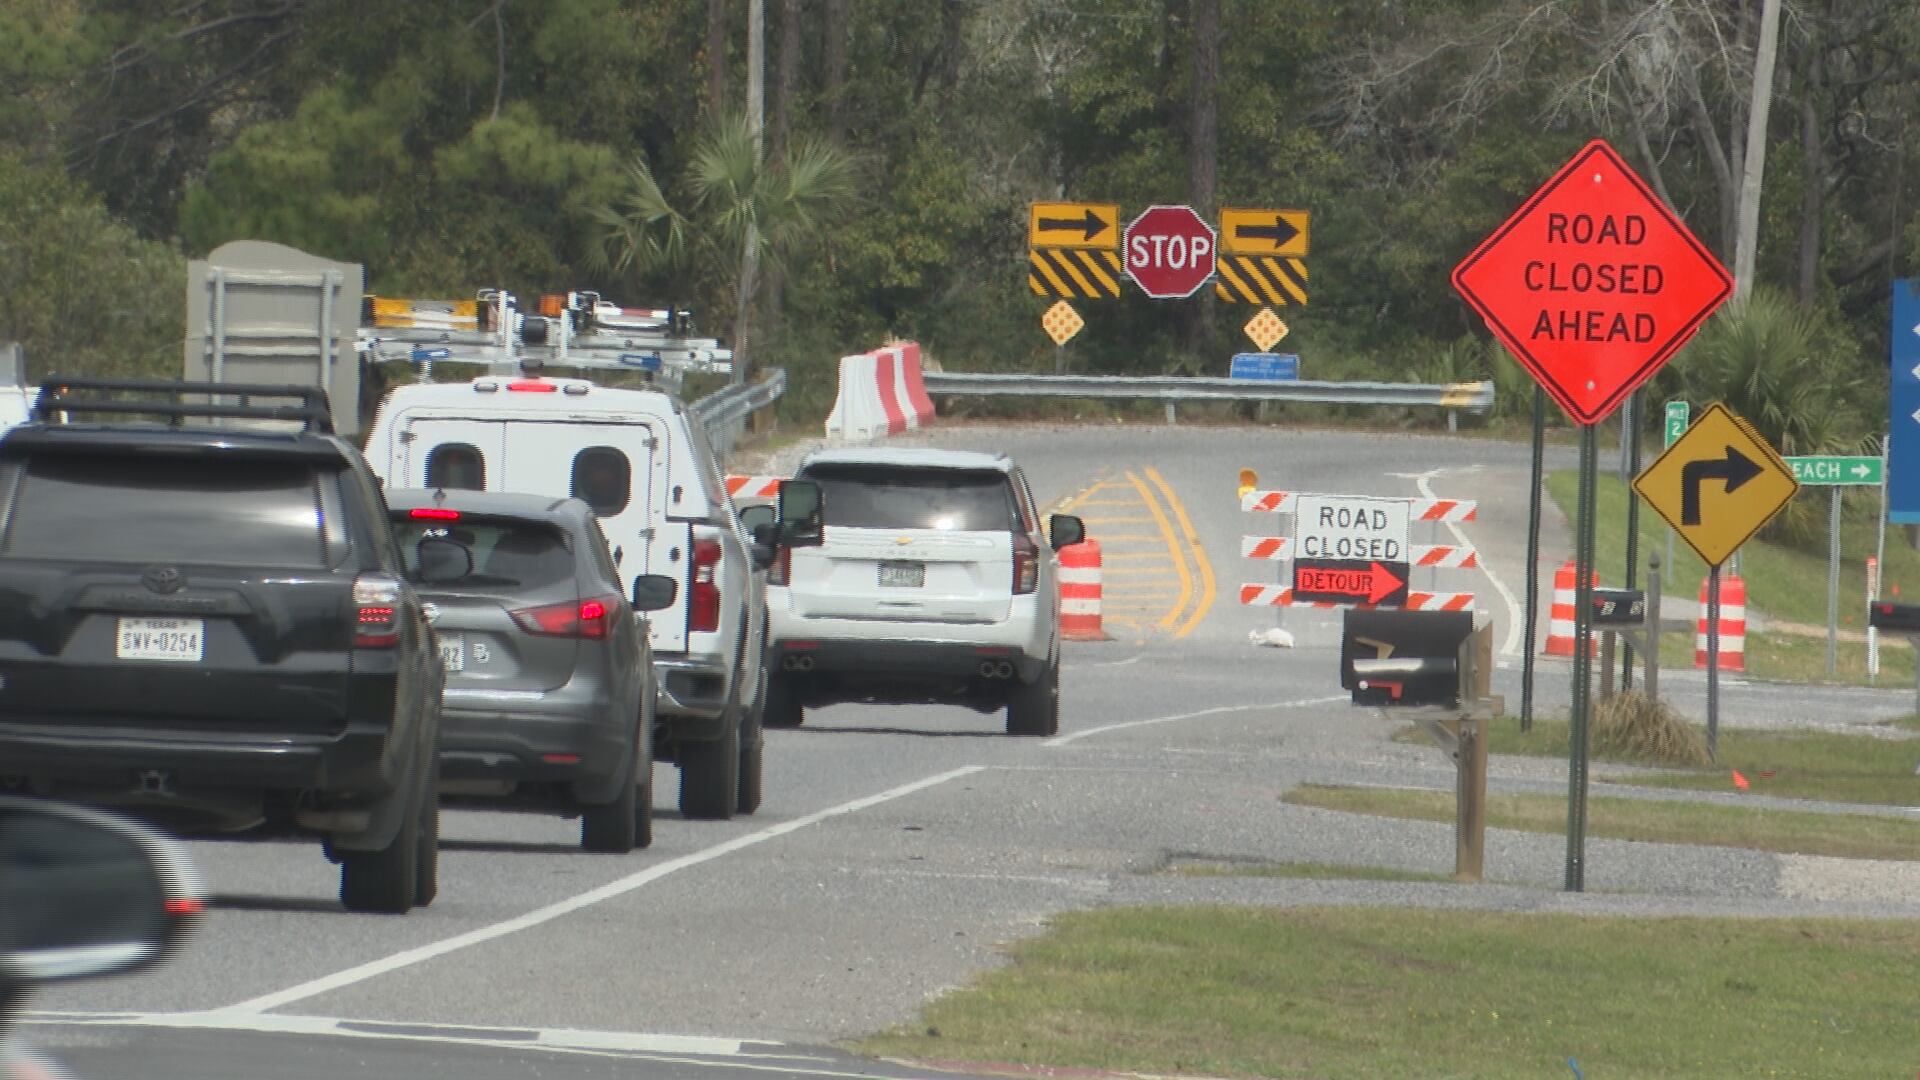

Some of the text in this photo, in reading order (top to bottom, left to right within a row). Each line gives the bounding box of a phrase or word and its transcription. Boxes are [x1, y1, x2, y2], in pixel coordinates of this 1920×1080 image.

[1548, 213, 1646, 246] ROAD
[1130, 235, 1210, 270] STOP
[1524, 261, 1664, 295] CLOSED
[1531, 310, 1656, 343] AHEAD
[1671, 421, 1682, 436] 2
[1319, 506, 1388, 531] ROAD
[1304, 535, 1400, 561] CLOSED
[1301, 572, 1373, 592] DETOUR
[146, 620, 178, 630] TEXAS
